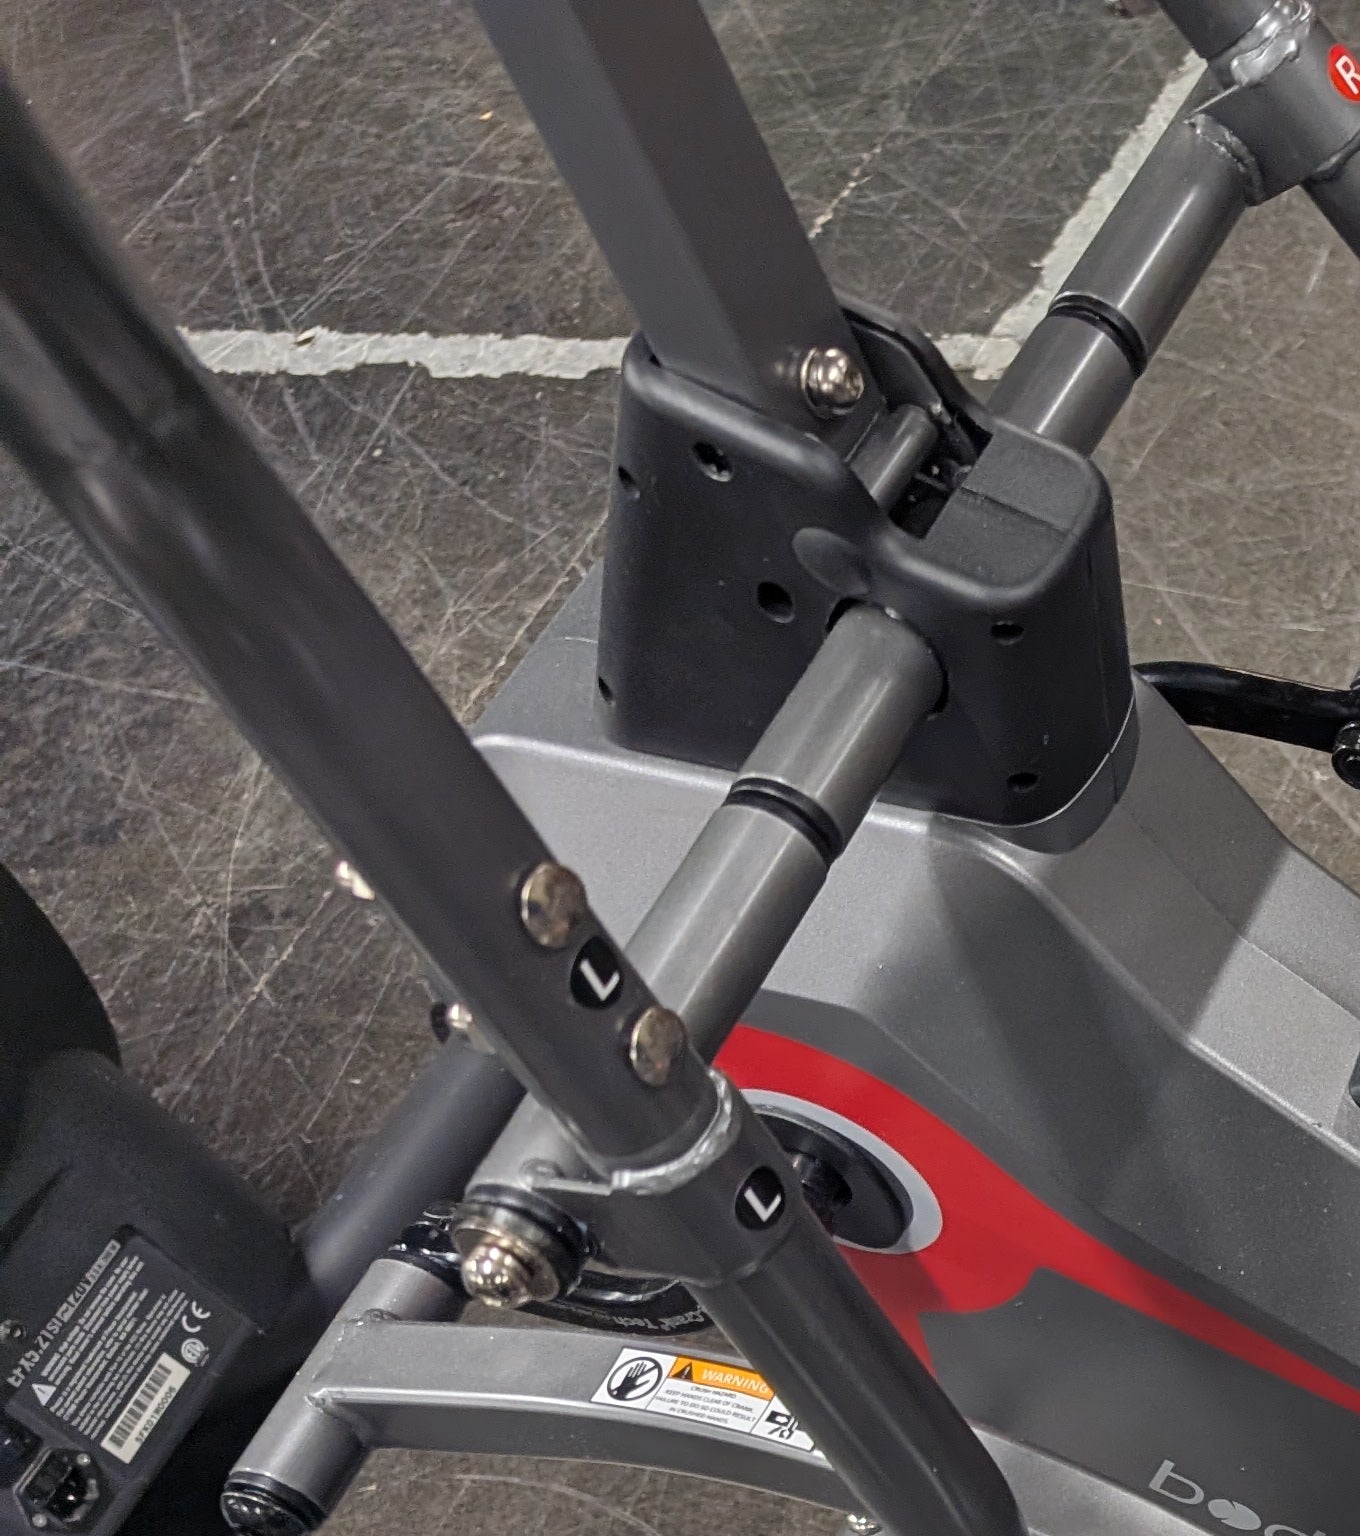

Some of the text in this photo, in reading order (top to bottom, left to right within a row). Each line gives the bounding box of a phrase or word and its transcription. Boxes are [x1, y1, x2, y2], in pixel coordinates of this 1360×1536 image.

[580, 958, 621, 1001] L
[743, 1186, 783, 1223] L
[701, 1368, 770, 1394] WARNING
